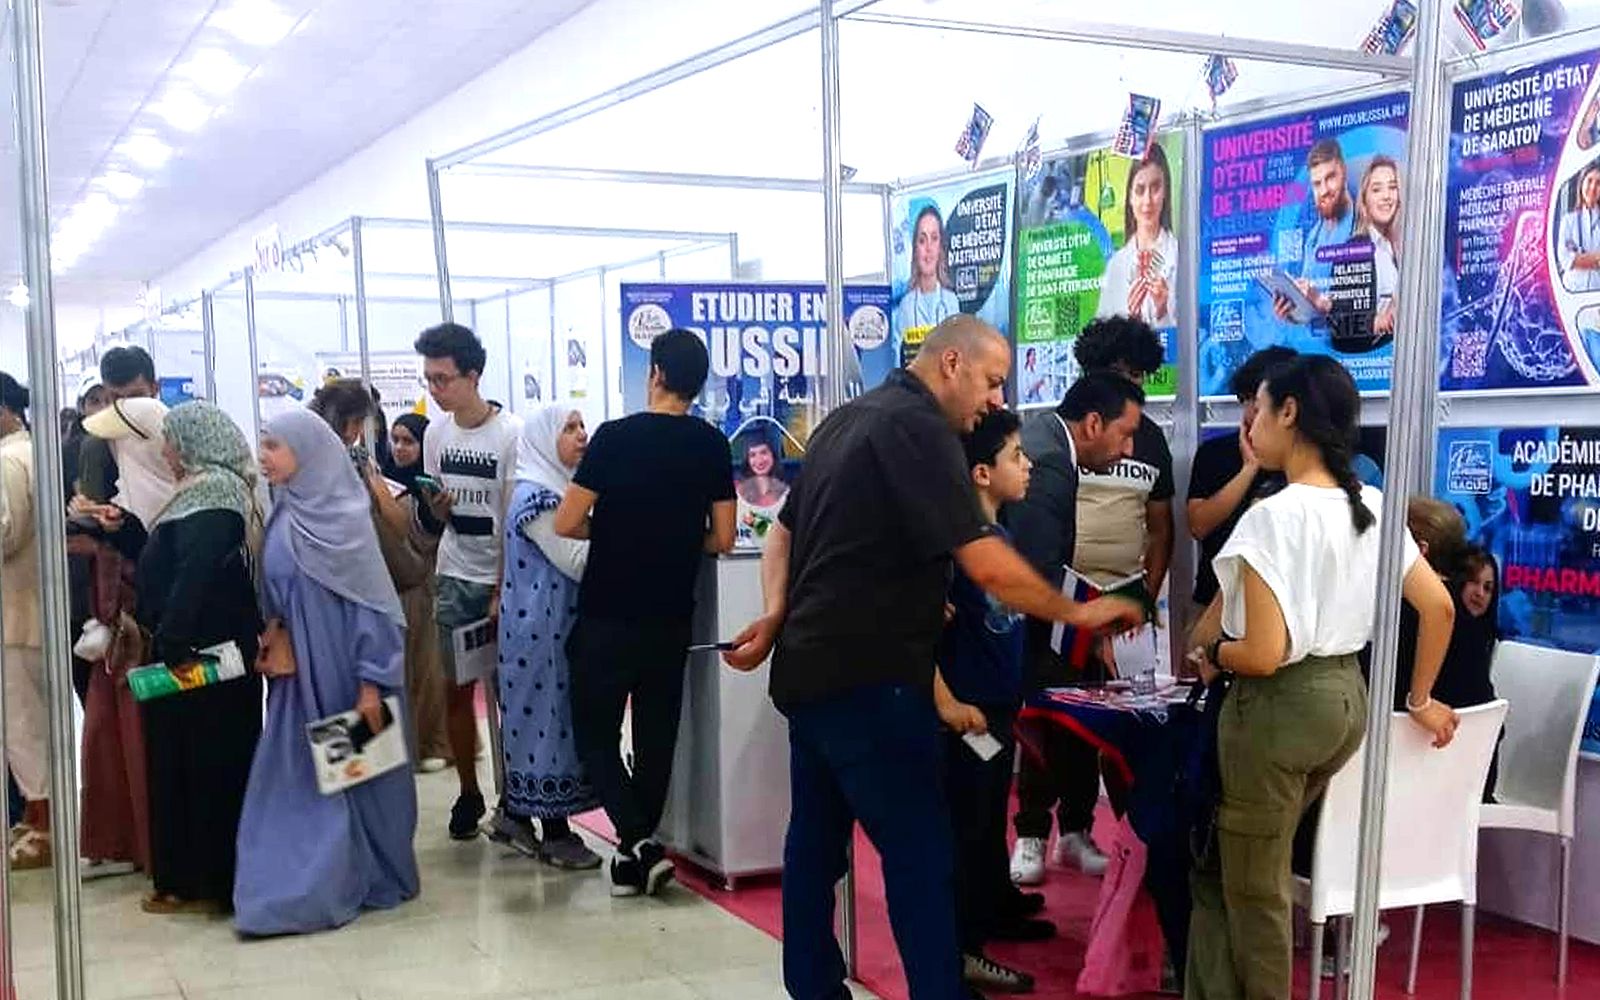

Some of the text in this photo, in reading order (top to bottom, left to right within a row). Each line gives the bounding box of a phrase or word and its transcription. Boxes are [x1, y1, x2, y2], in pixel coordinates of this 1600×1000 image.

[1463, 63, 1591, 111] UNIVERSITÉ D'ÉTAT
[1463, 97, 1554, 134] DE MÉDECINE
[1213, 116, 1314, 162] UNIVERSITÉ
[1462, 122, 1542, 157] DE SARATOV
[1213, 158, 1266, 190] D'ÉTAT
[957, 191, 1003, 218] UNIVERSITÉ
[1213, 192, 1233, 218] DE
[692, 292, 827, 322] ETUDIER EN
[1531, 474, 1555, 496] DE
